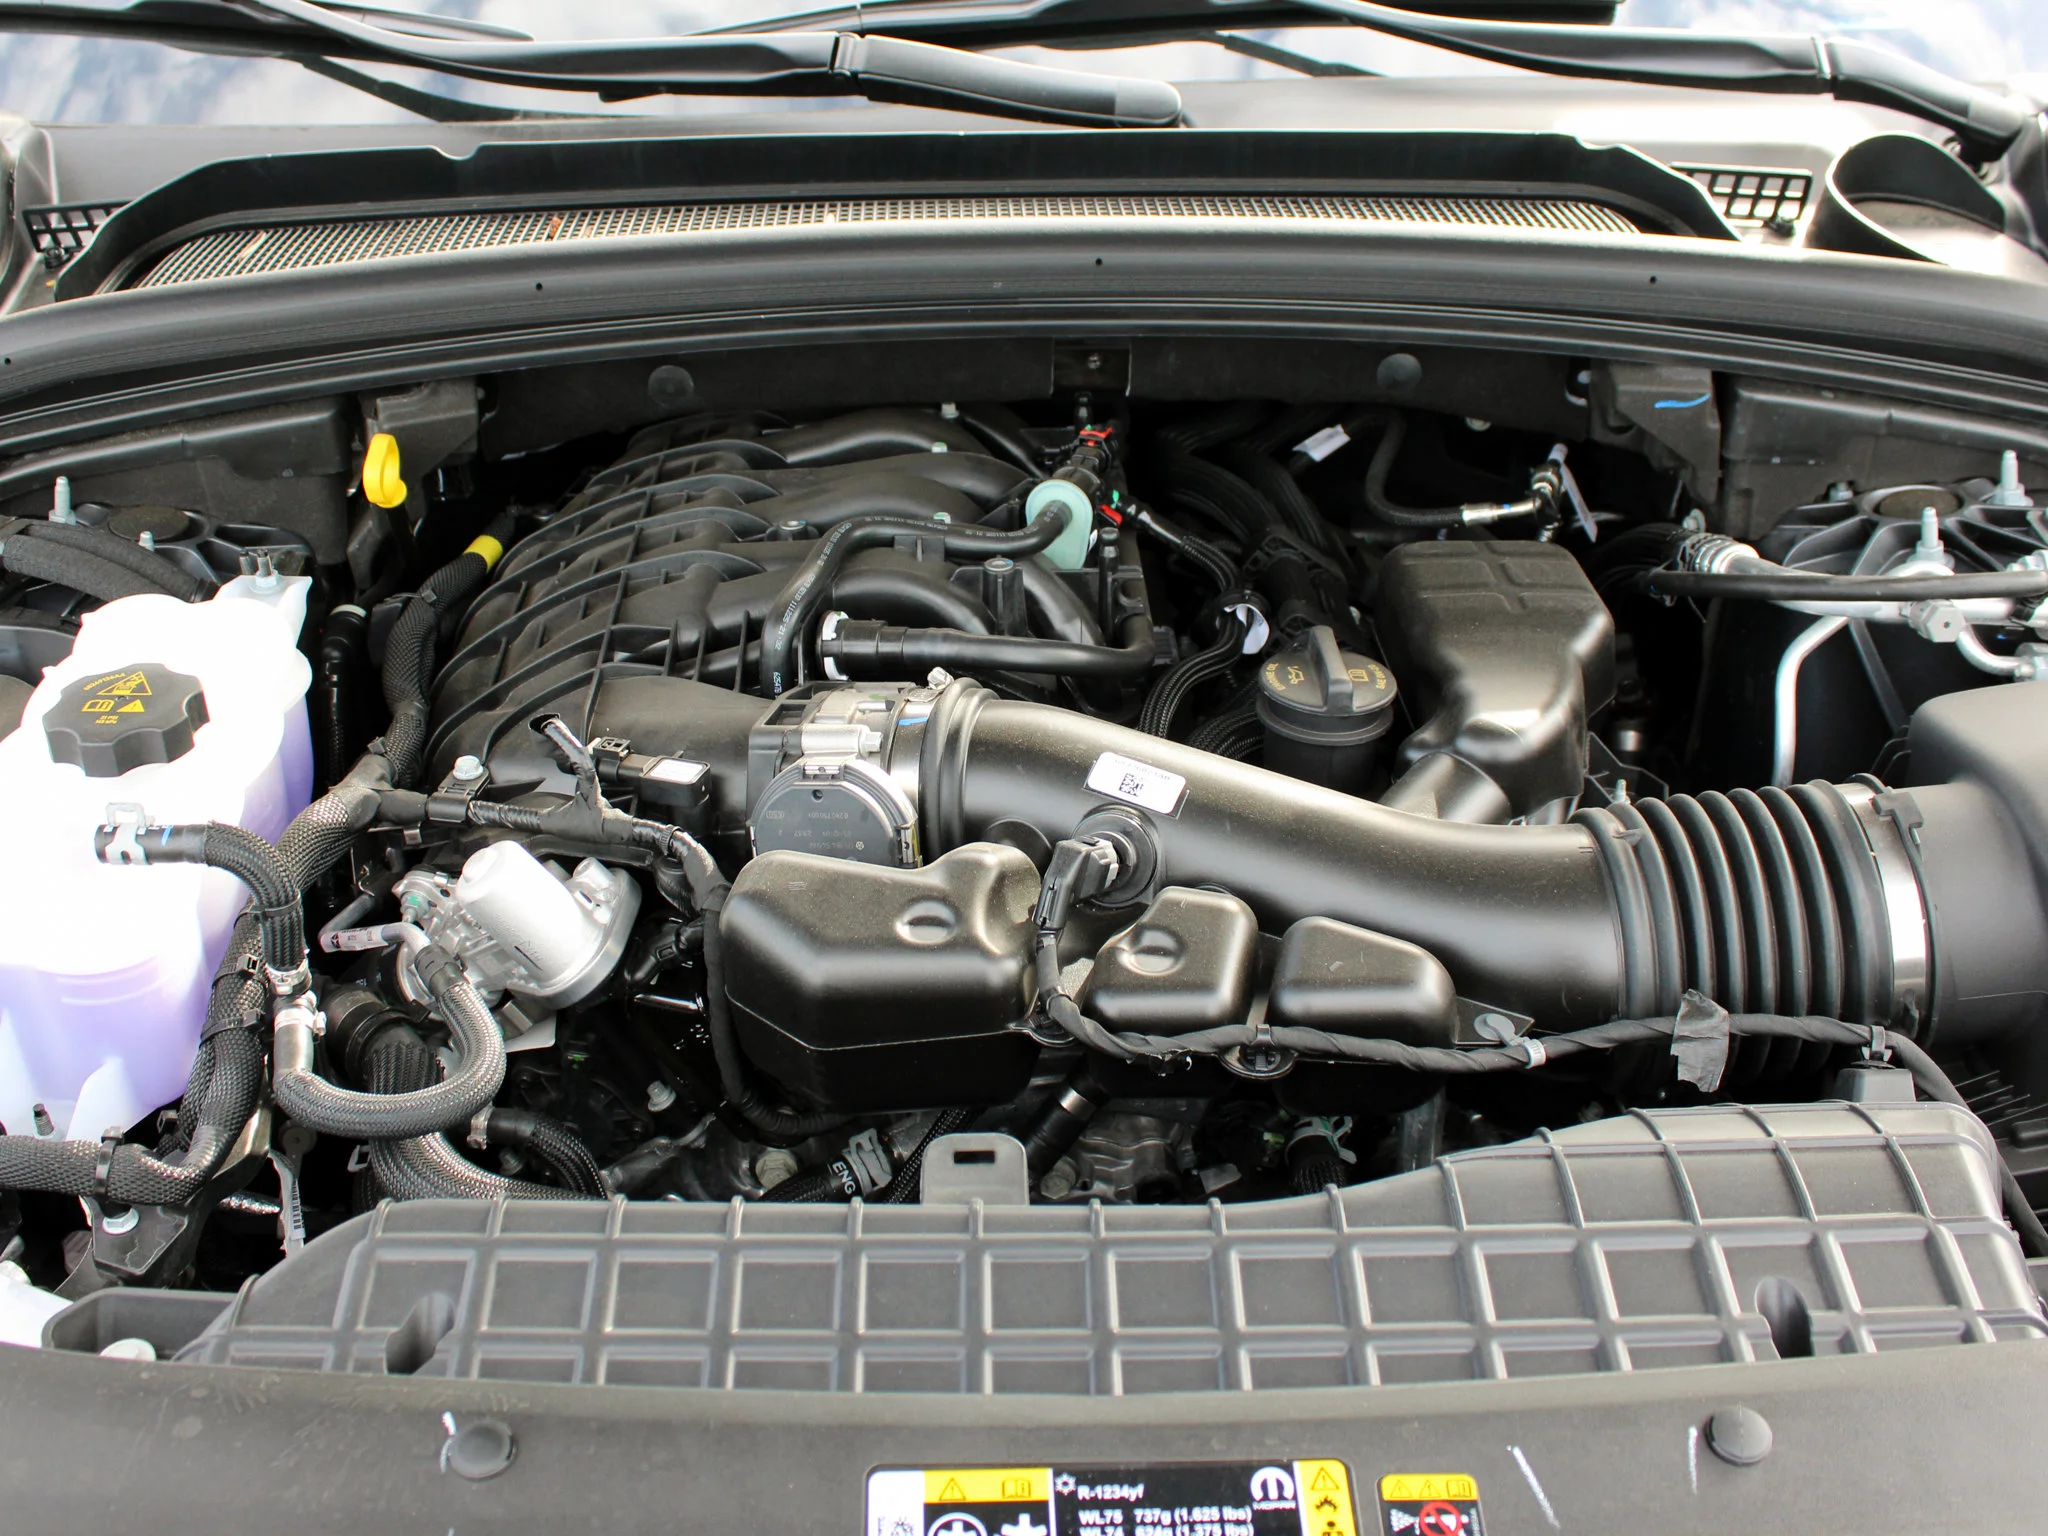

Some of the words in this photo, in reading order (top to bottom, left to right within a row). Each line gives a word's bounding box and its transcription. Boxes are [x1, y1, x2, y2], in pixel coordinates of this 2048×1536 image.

[832, 1161, 856, 1195] ENG
[1077, 1483, 1145, 1502] R-1234yf
[1078, 1508, 1123, 1526] WL75
[1133, 1507, 1172, 1526] 737g
[1174, 1506, 1220, 1525] (1.625
[1221, 1505, 1252, 1524] lbs)
